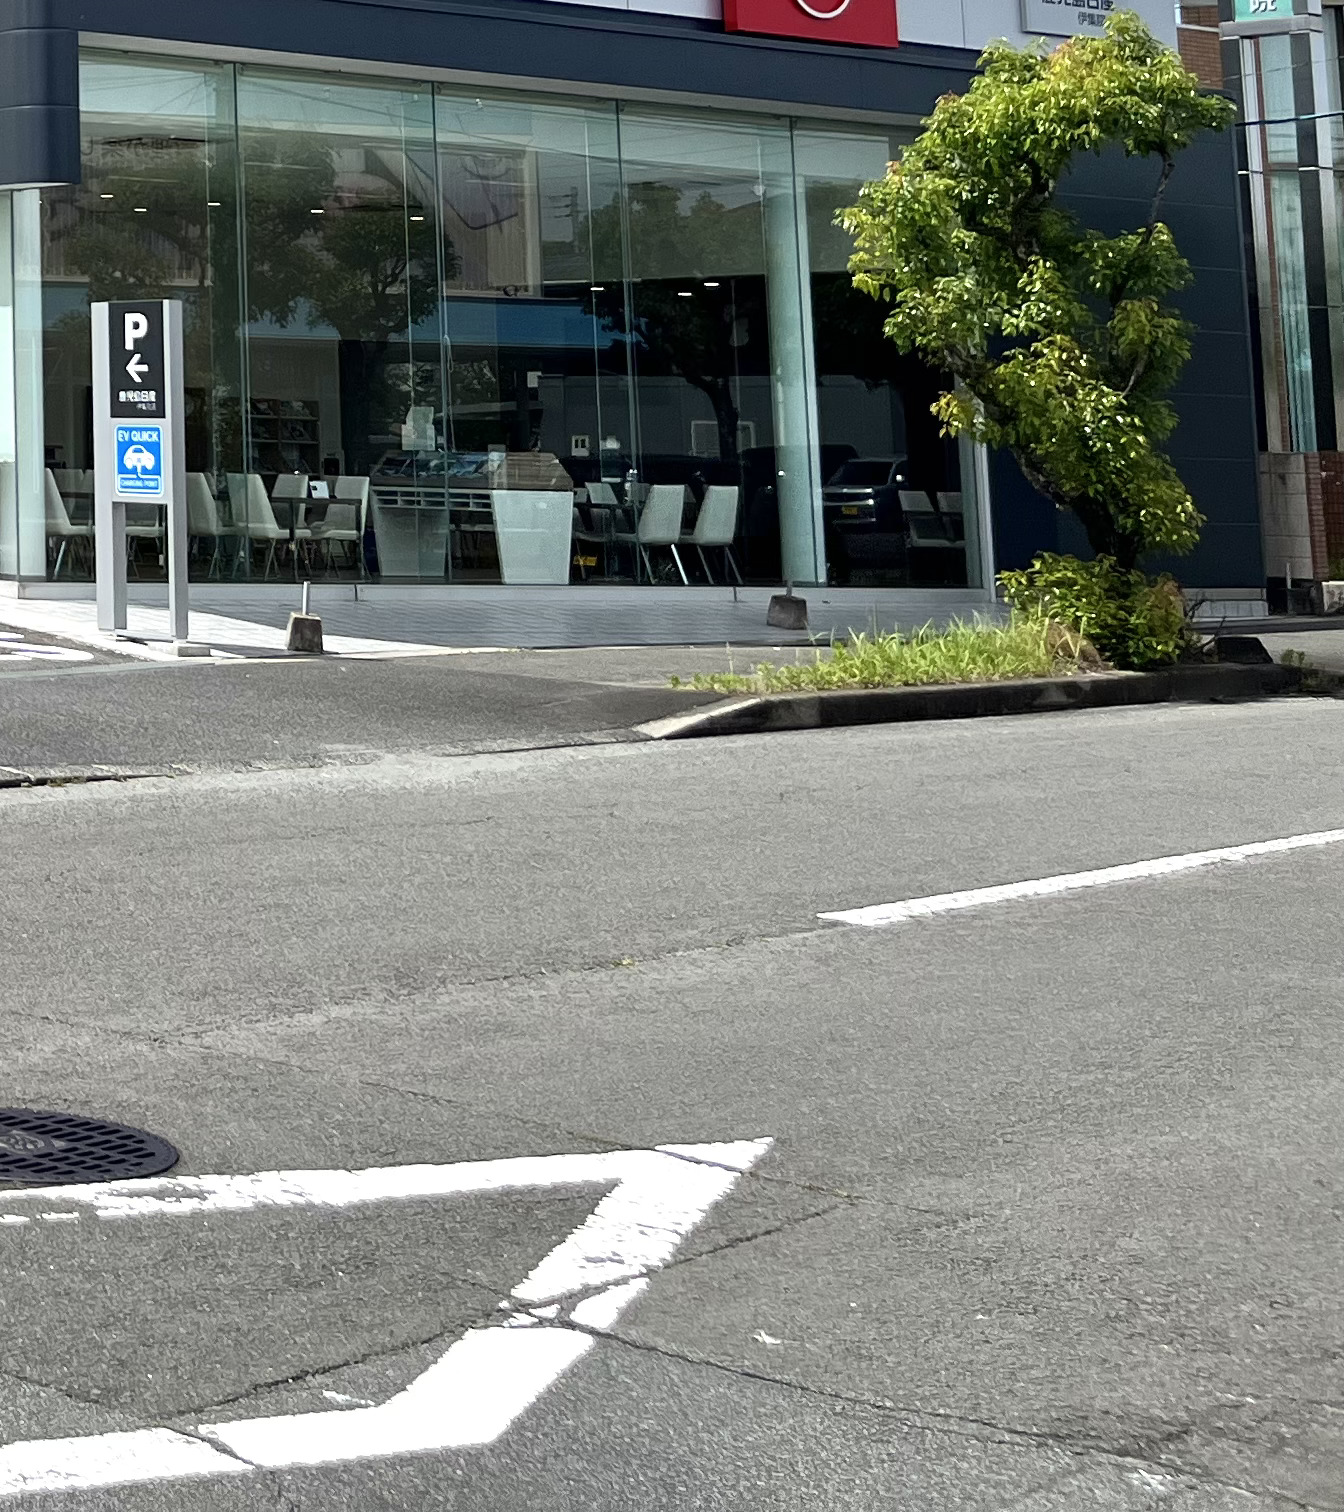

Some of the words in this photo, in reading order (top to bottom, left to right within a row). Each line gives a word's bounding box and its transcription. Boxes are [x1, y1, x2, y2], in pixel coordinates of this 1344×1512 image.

[123, 312, 148, 351] P
[117, 430, 129, 442] EV
[131, 430, 160, 442] QUICK
